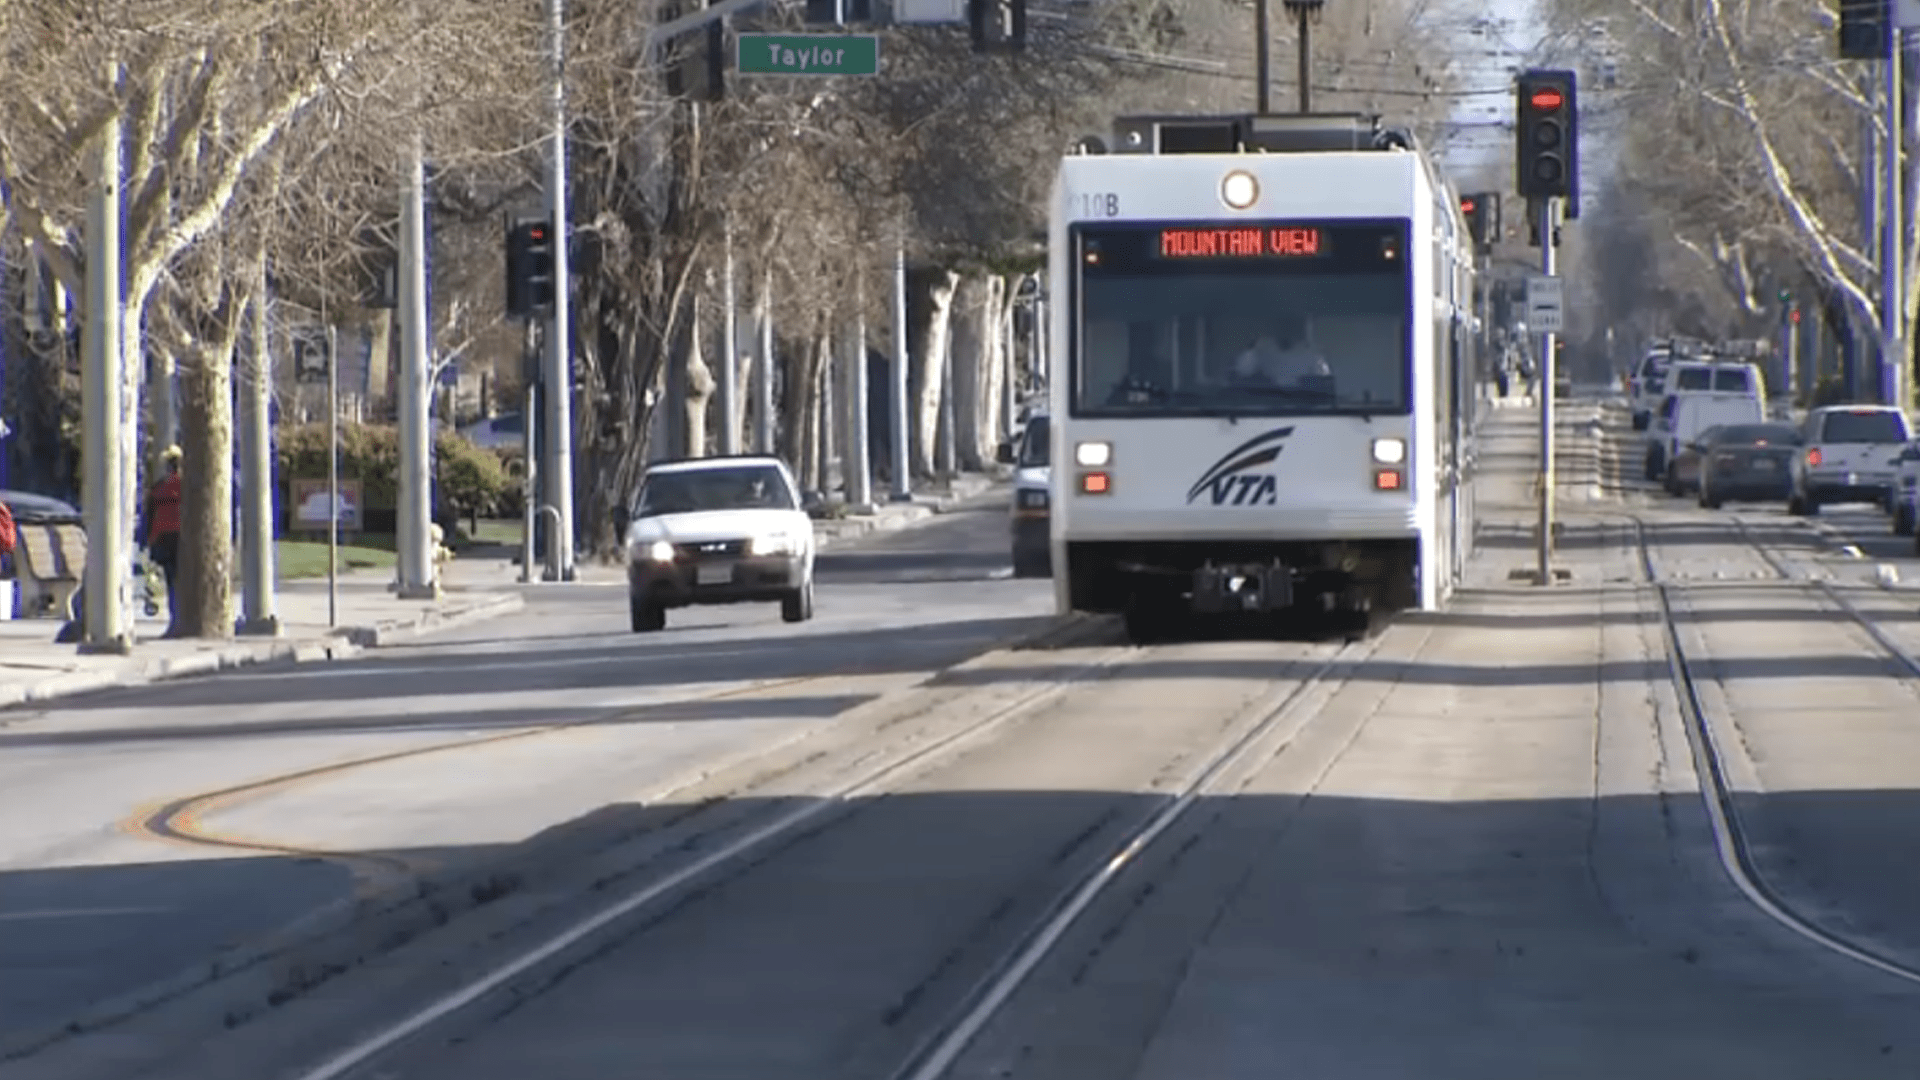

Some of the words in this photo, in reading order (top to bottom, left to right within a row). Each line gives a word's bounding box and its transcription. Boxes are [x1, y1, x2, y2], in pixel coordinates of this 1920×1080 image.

[769, 43, 845, 70] Taylor
[1161, 230, 1263, 255] MOUNTAIN
[1270, 229, 1318, 254] VIEW
[1210, 475, 1276, 505] VTA
